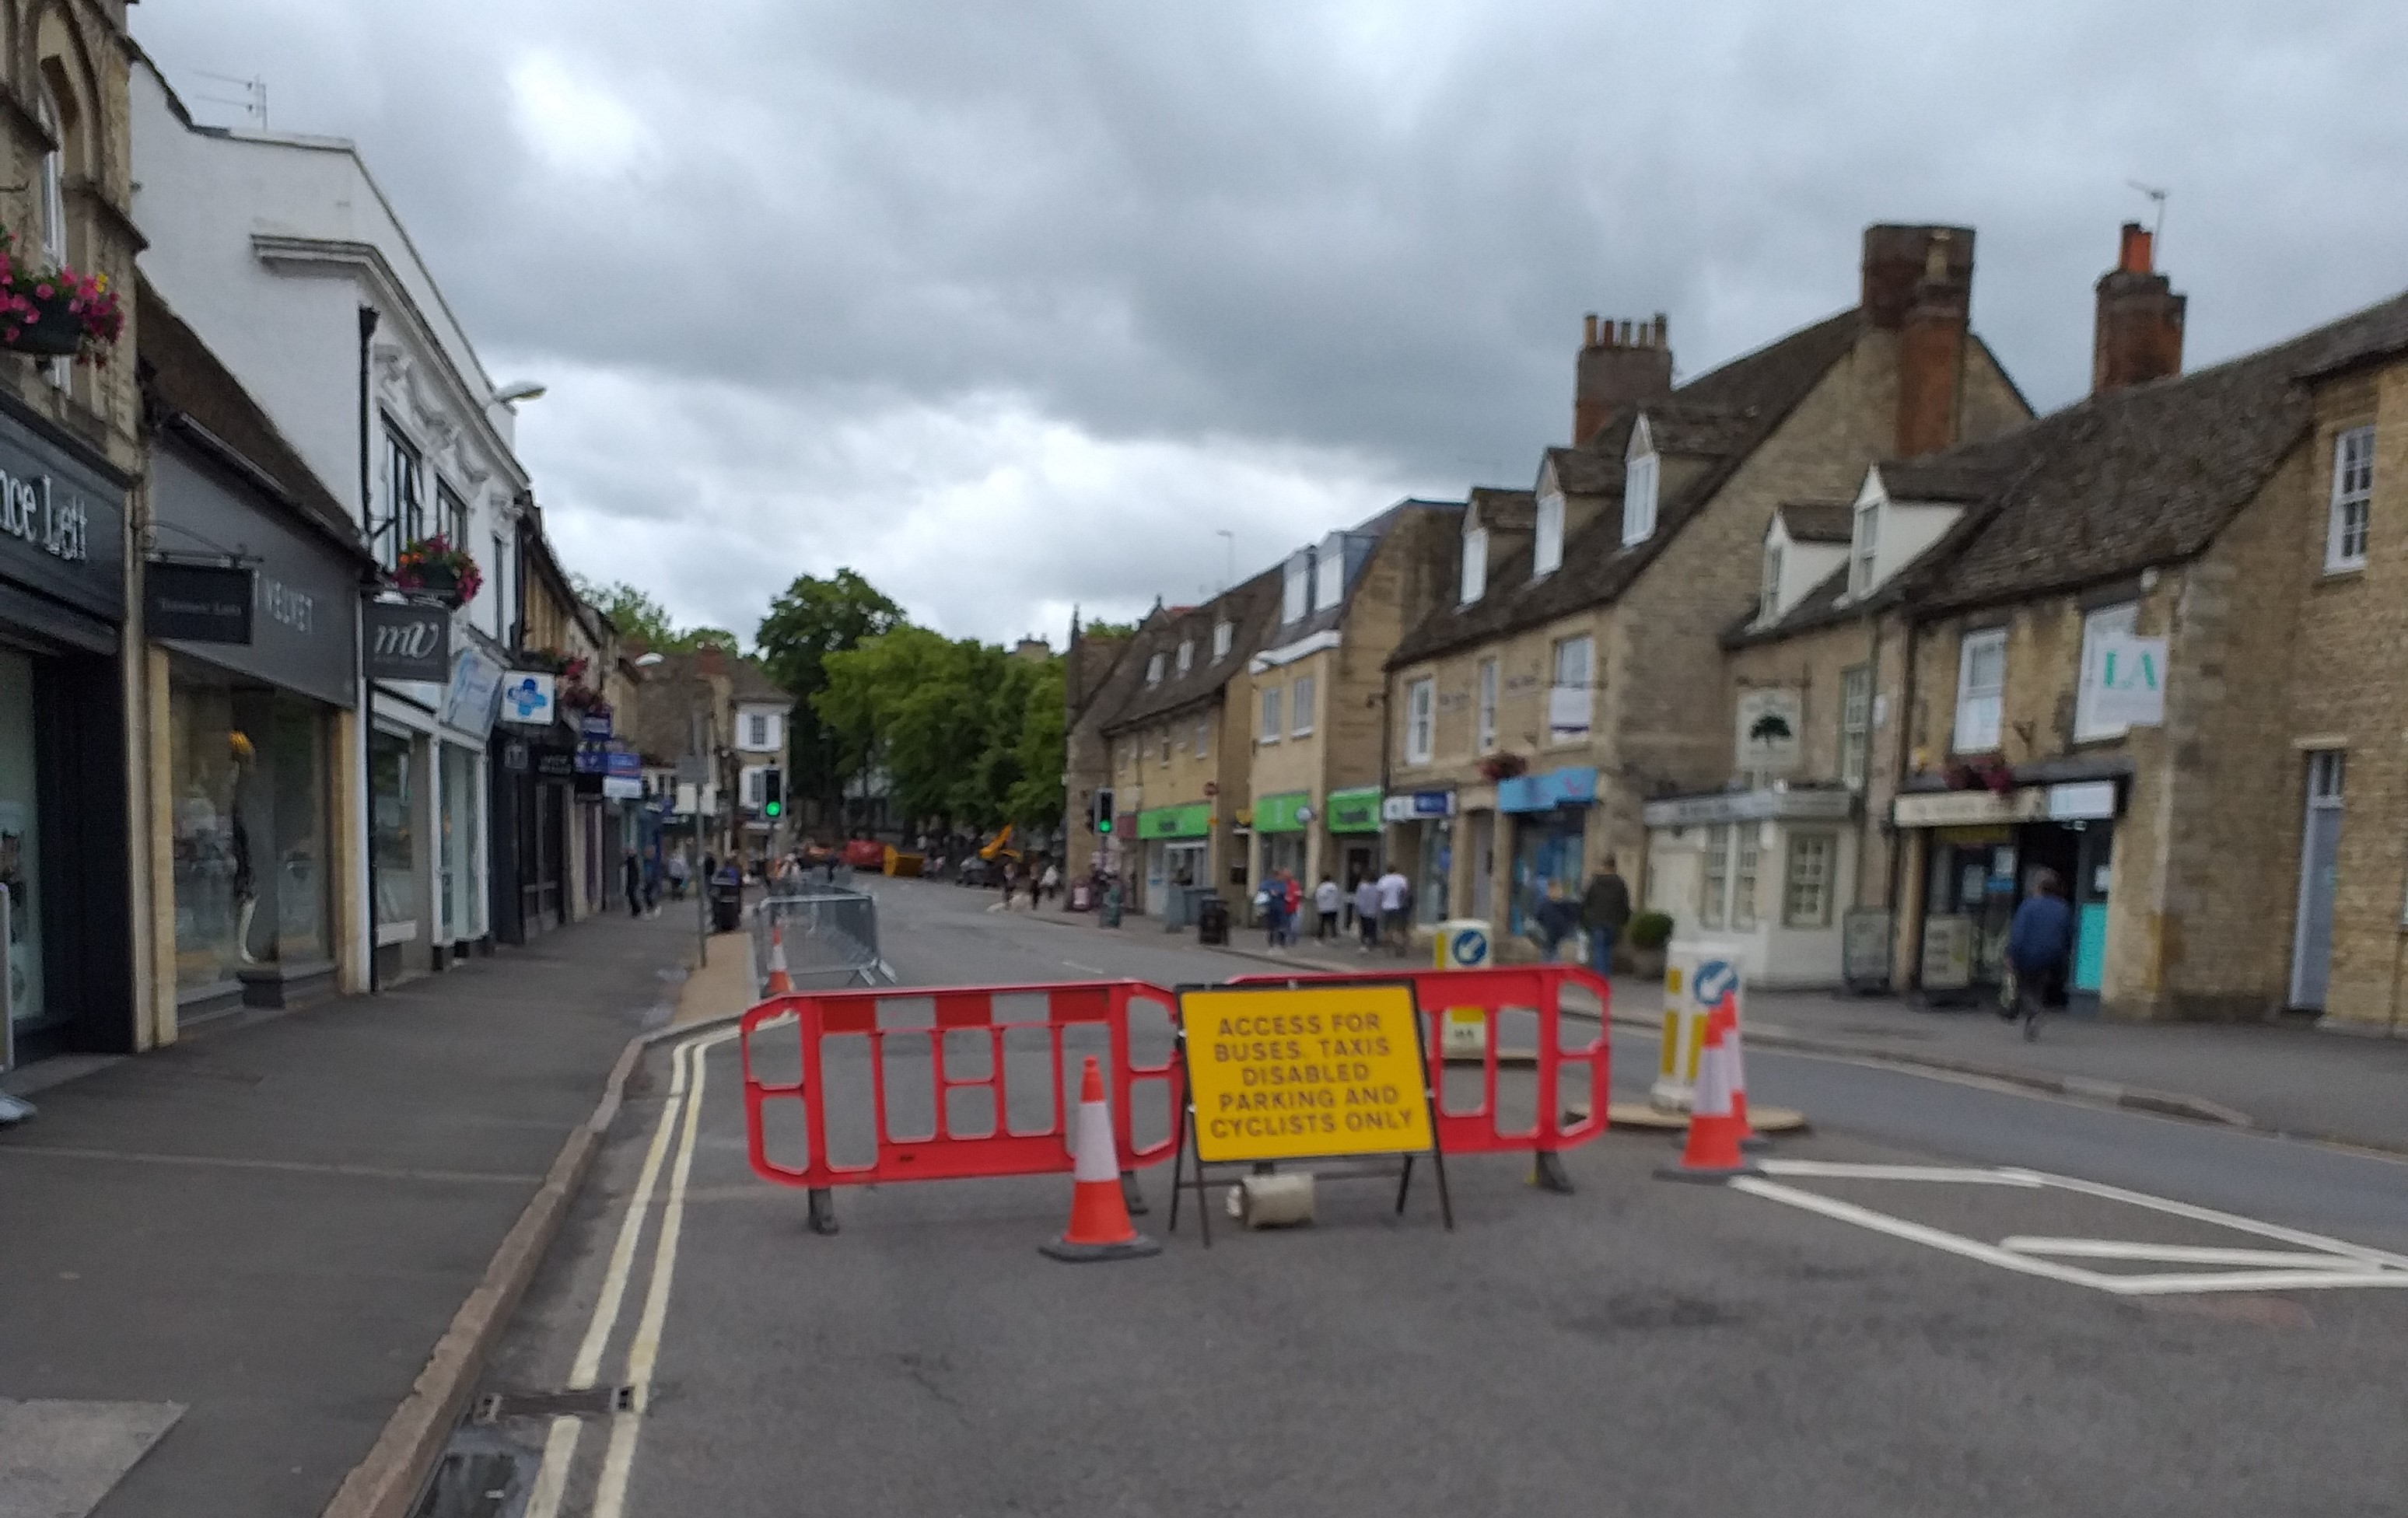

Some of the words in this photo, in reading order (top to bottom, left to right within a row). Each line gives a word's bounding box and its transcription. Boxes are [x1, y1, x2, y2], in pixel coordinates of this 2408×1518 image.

[1218, 1015, 1322, 1037] ACCESS
[1332, 1013, 1381, 1032] FOR
[1318, 1037, 1390, 1058] TAXIS
[1242, 1063, 1370, 1086] DISABLED
[1219, 1090, 1336, 1111] PARKING
[1346, 1086, 1398, 1107] AND
[1210, 1114, 1337, 1138] CYCLISTS
[1346, 1109, 1412, 1132] ONLY
